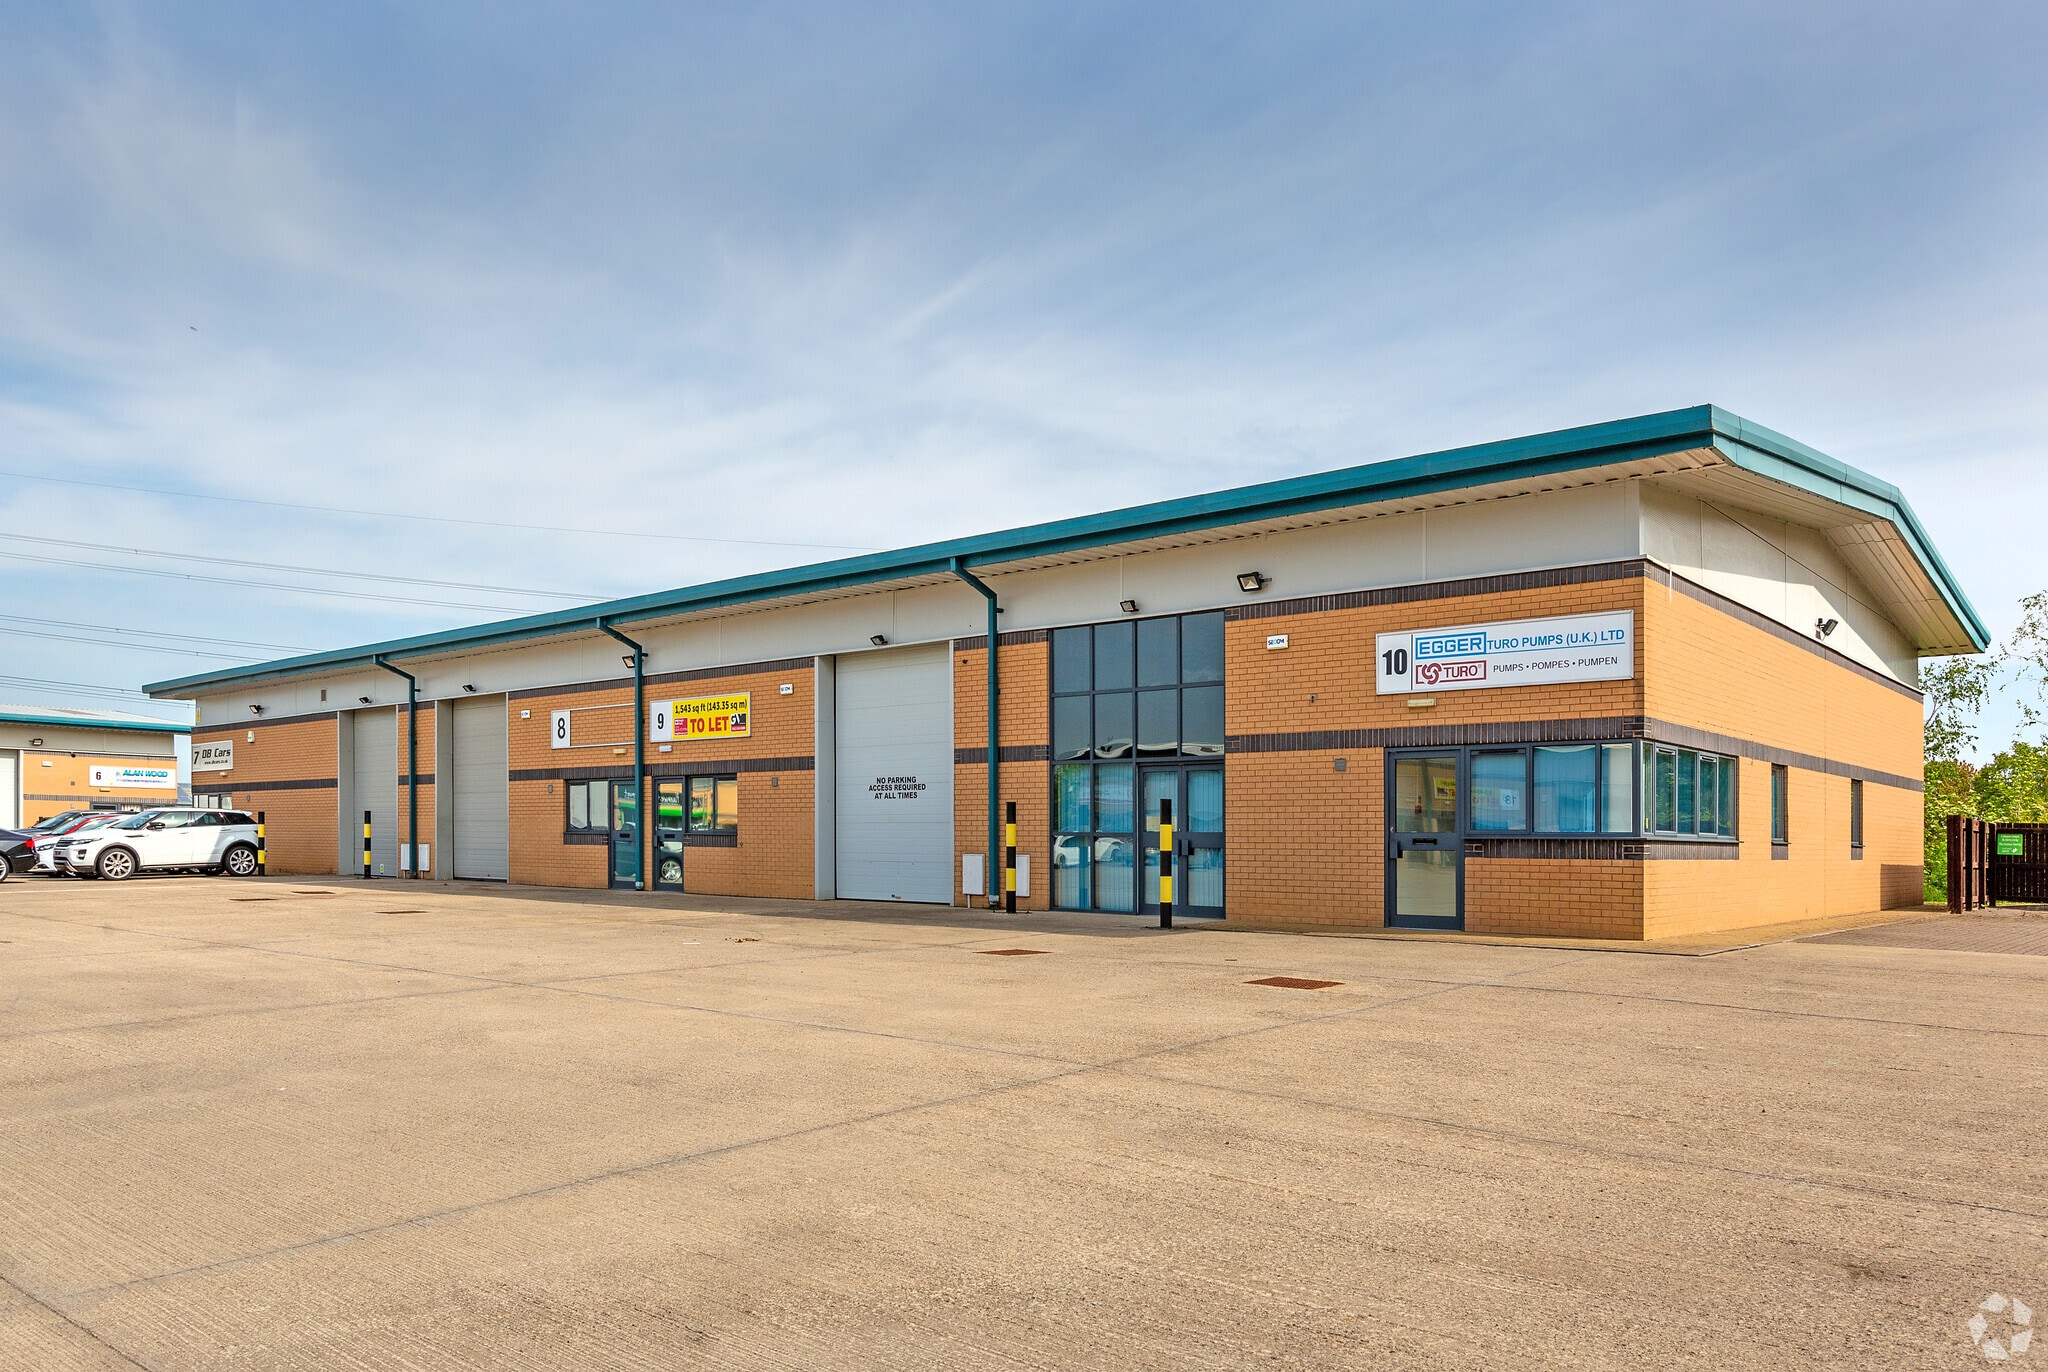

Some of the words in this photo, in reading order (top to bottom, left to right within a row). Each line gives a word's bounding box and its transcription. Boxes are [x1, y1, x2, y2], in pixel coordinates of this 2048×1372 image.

[1419, 637, 1482, 655] EGGER
[1487, 638, 1519, 650] TURO
[1522, 634, 1563, 648] PUMPS
[1566, 631, 1598, 646] (U.K.)
[1600, 629, 1625, 641] LTD
[1382, 649, 1408, 676] 10
[1493, 663, 1524, 673] PUMPS
[1531, 660, 1570, 671] POMPES
[1578, 656, 1618, 667] PUMPEN
[675, 704, 691, 715] 1,543
[692, 705, 700, 714] sq
[700, 703, 706, 712] ft
[706, 701, 729, 712] (143.35
[730, 702, 738, 710] sq
[738, 699, 748, 709] m)
[557, 717, 566, 739] 8
[657, 713, 665, 730] 9
[690, 718, 705, 733] TO
[708, 716, 729, 732] LET
[193, 751, 200, 765] 7
[201, 749, 212, 759] DB
[214, 748, 231, 758] Cars
[95, 771, 102, 781] 6
[887, 776, 917, 784] PARKING
[898, 791, 918, 799] TIMES
